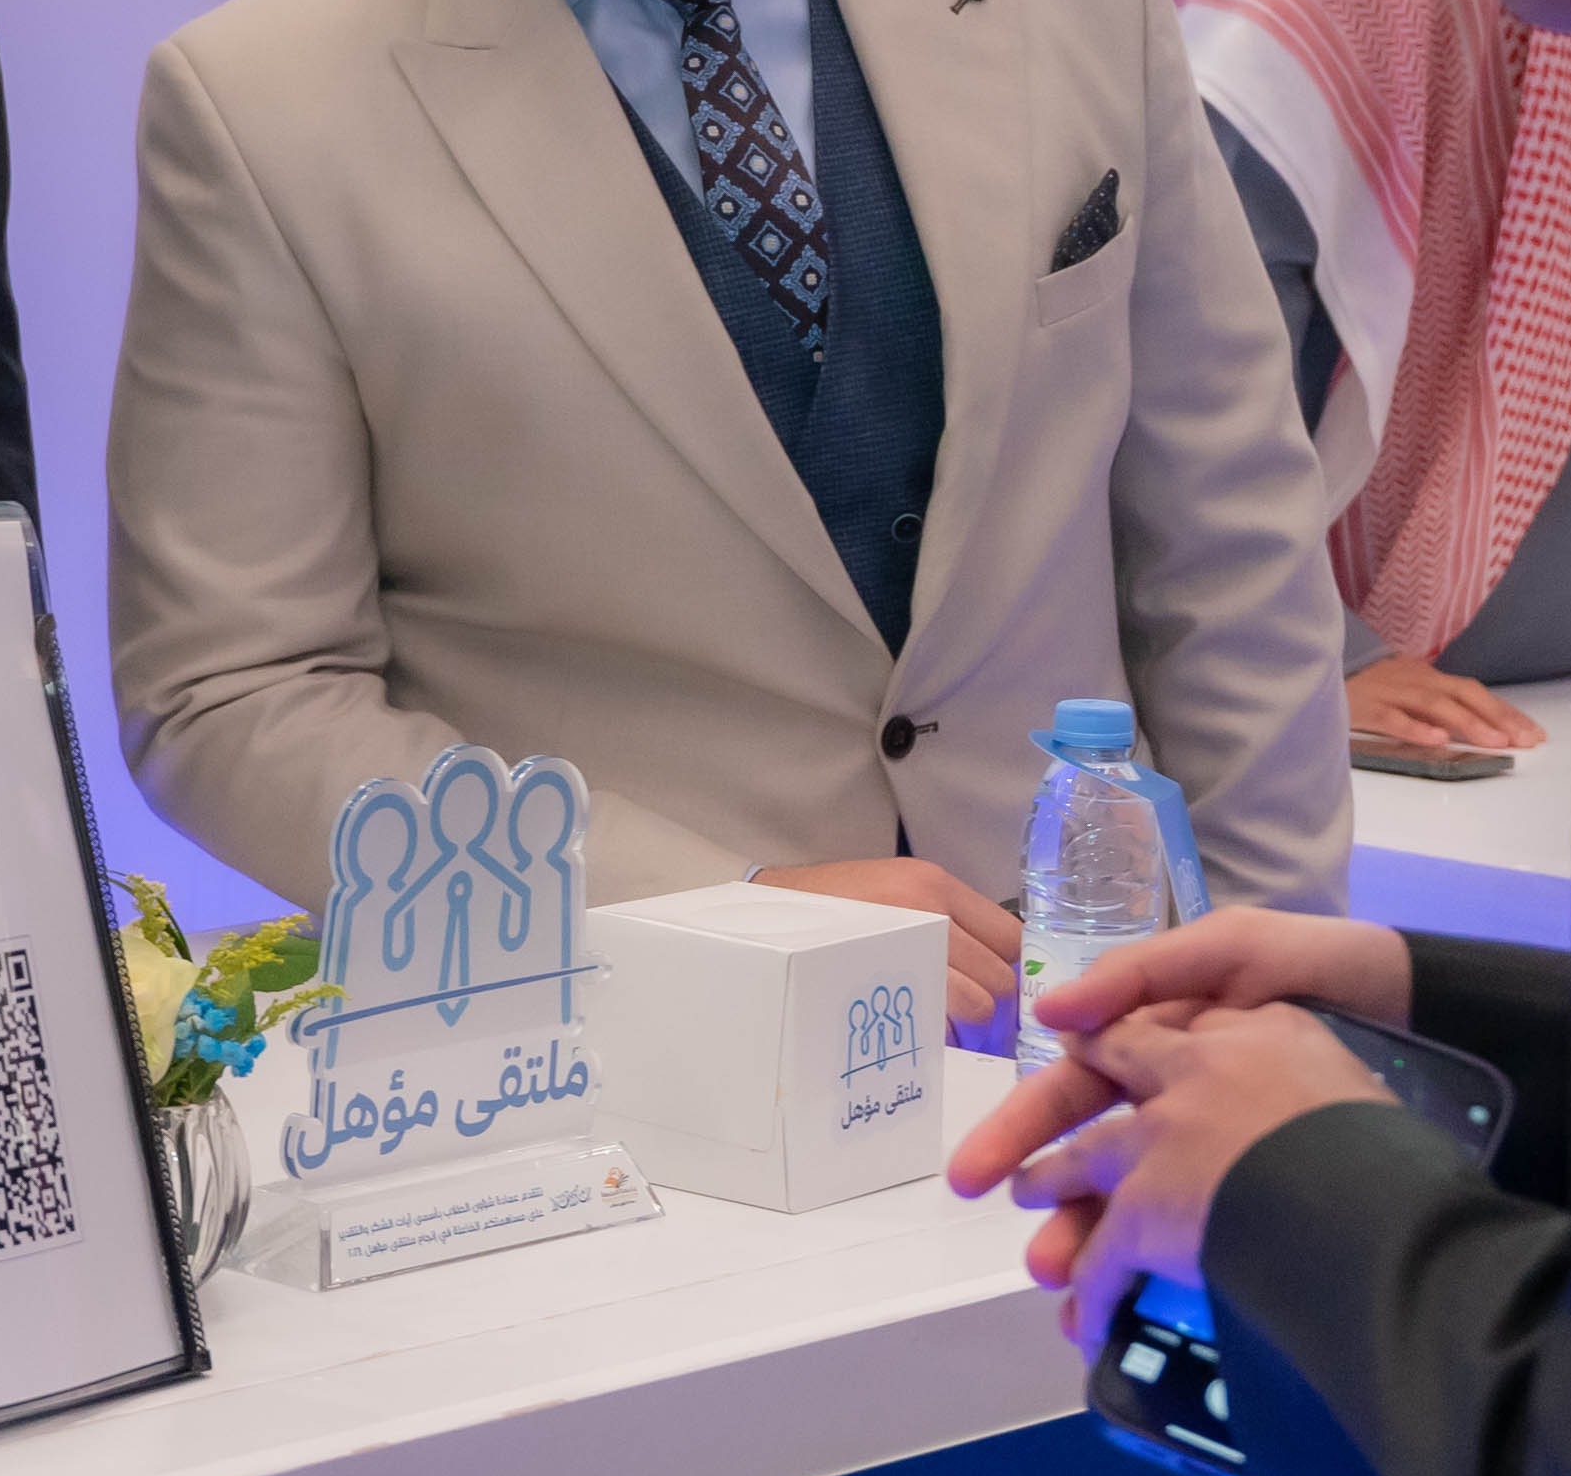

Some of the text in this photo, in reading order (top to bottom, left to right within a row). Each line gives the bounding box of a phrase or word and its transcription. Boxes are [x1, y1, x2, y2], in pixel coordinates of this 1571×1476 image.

[296, 1039, 589, 1169] ملتقى مؤهل
[841, 1081, 922, 1130] ملتقى مؤهل
